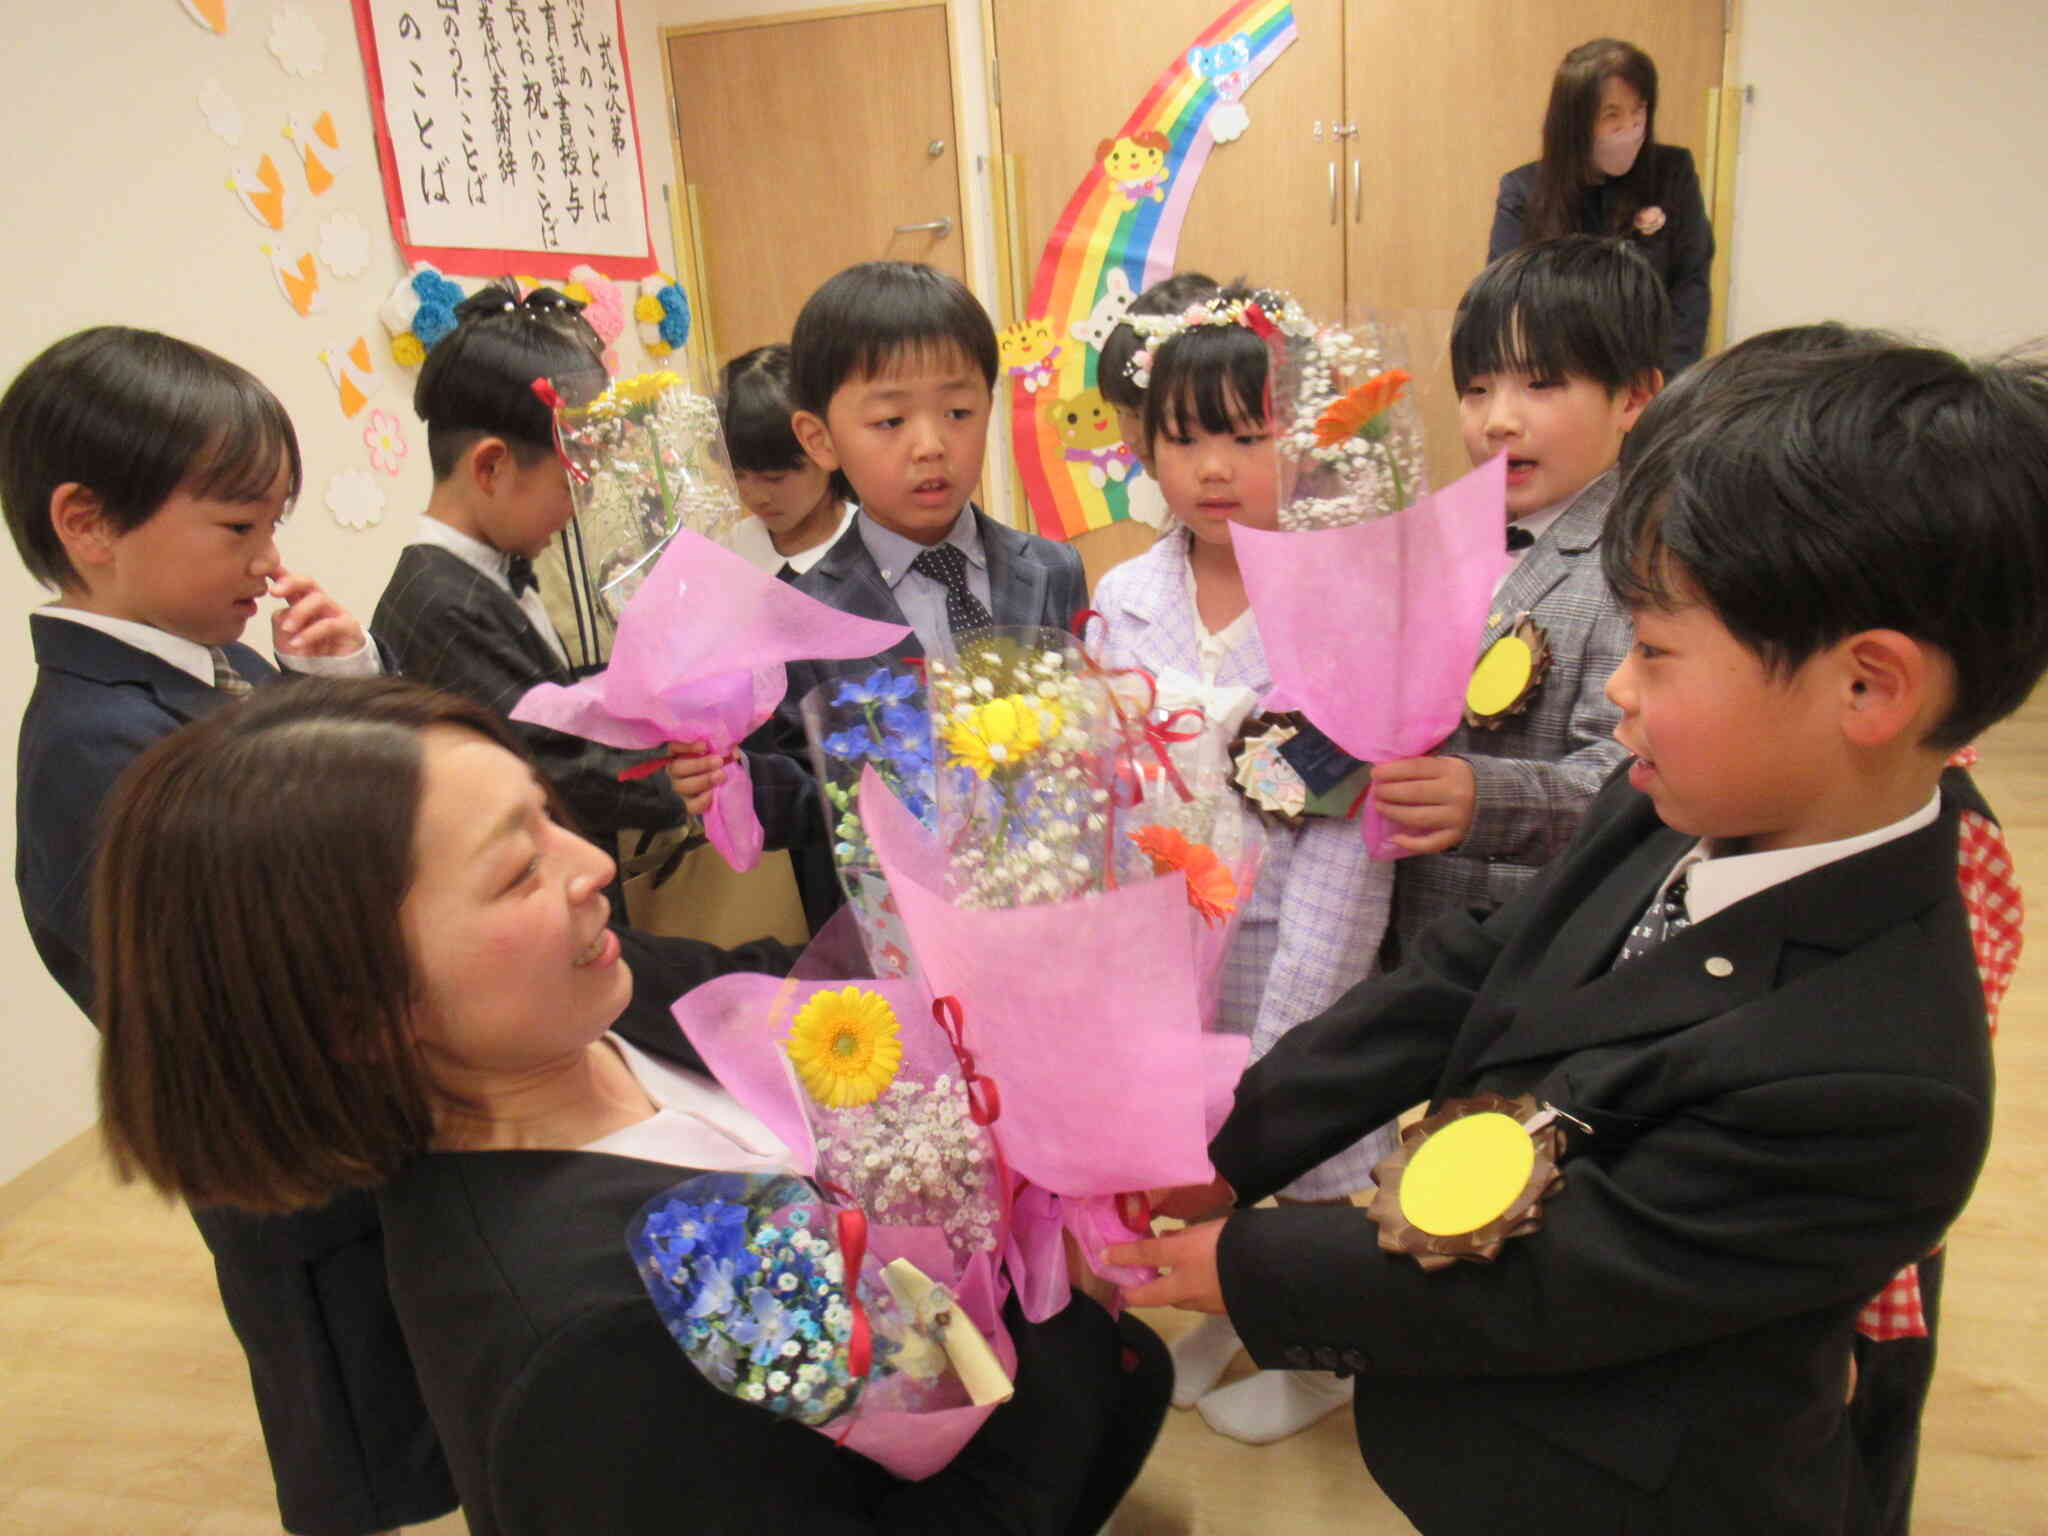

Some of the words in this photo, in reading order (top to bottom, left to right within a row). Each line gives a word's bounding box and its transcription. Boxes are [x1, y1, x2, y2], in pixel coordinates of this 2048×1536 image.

[399, 12, 450, 206] のことば
[478, 0, 516, 188] 者代表謝辞
[567, 0, 611, 222] 式のことば
[598, 32, 626, 158] 式次第
